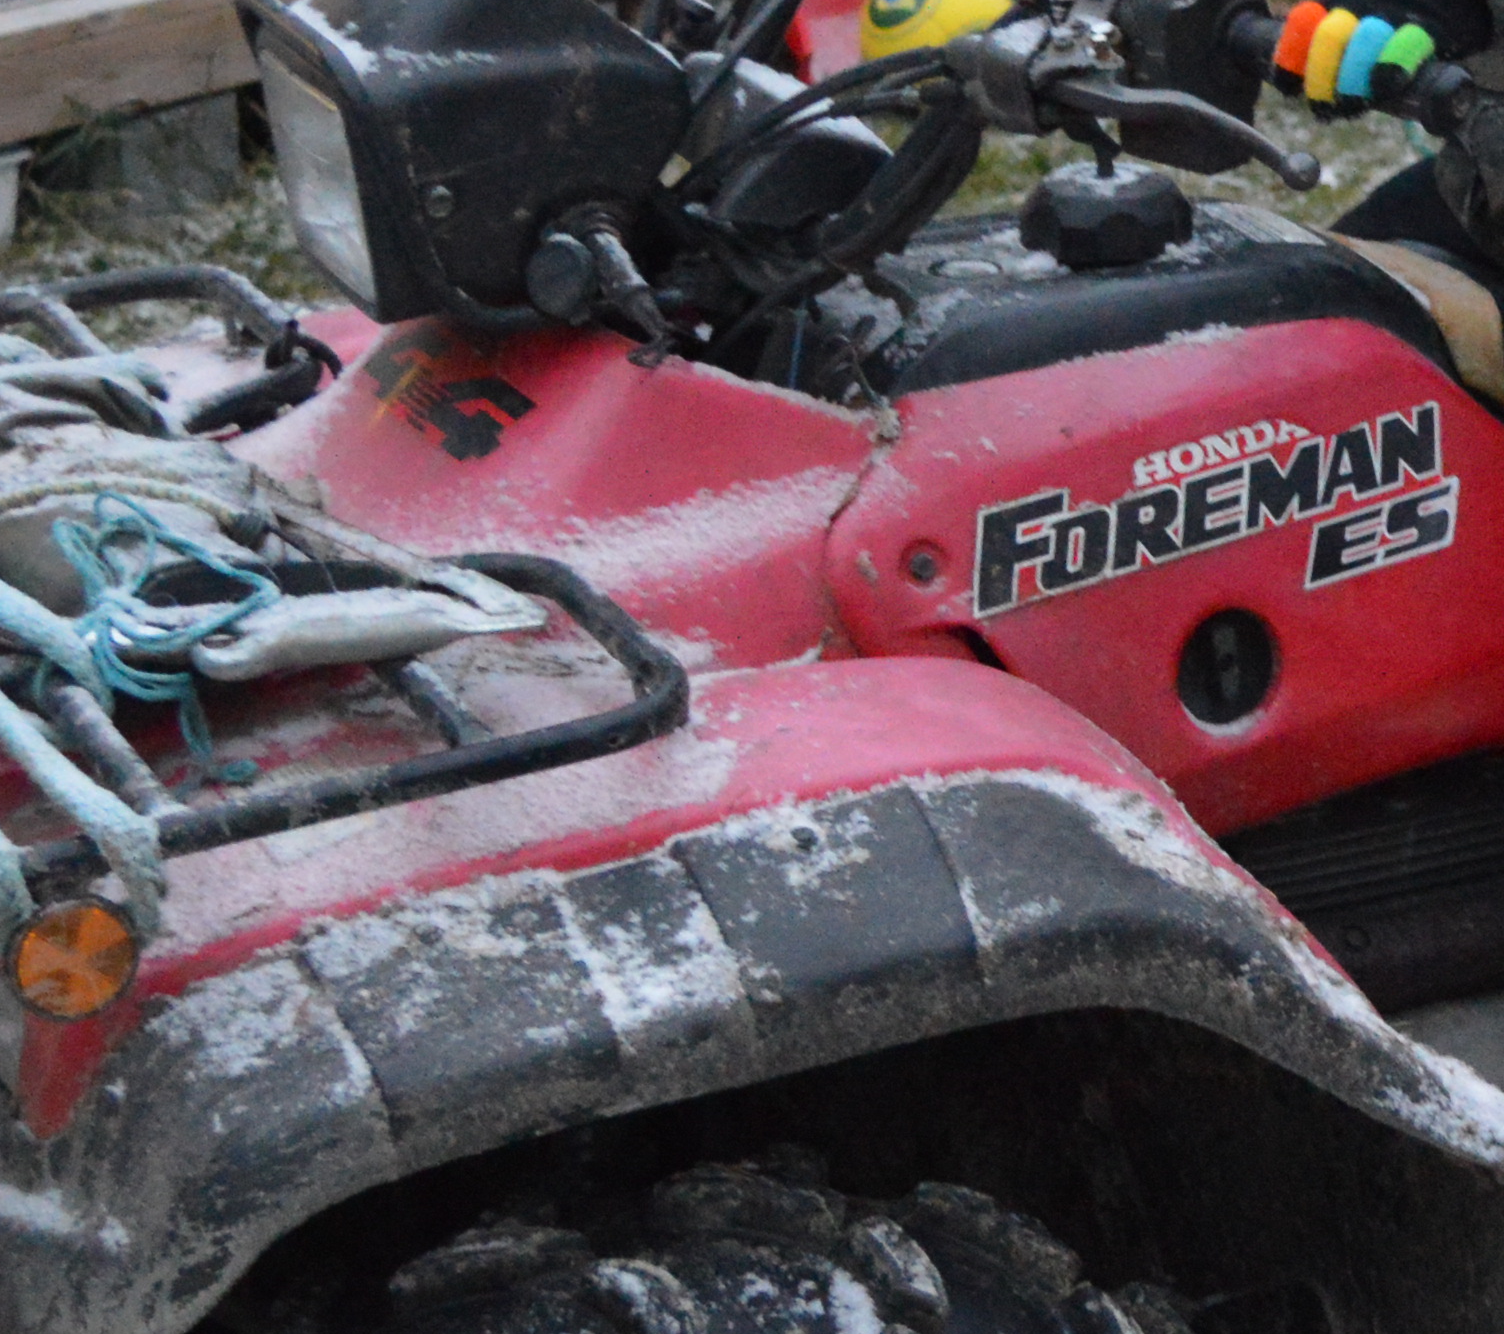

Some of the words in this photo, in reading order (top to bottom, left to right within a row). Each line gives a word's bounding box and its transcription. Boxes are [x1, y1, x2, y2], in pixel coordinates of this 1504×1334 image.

[973, 400, 1440, 618] FOREMAN
[1133, 419, 1310, 486] HONDA
[1303, 476, 1460, 590] ES
